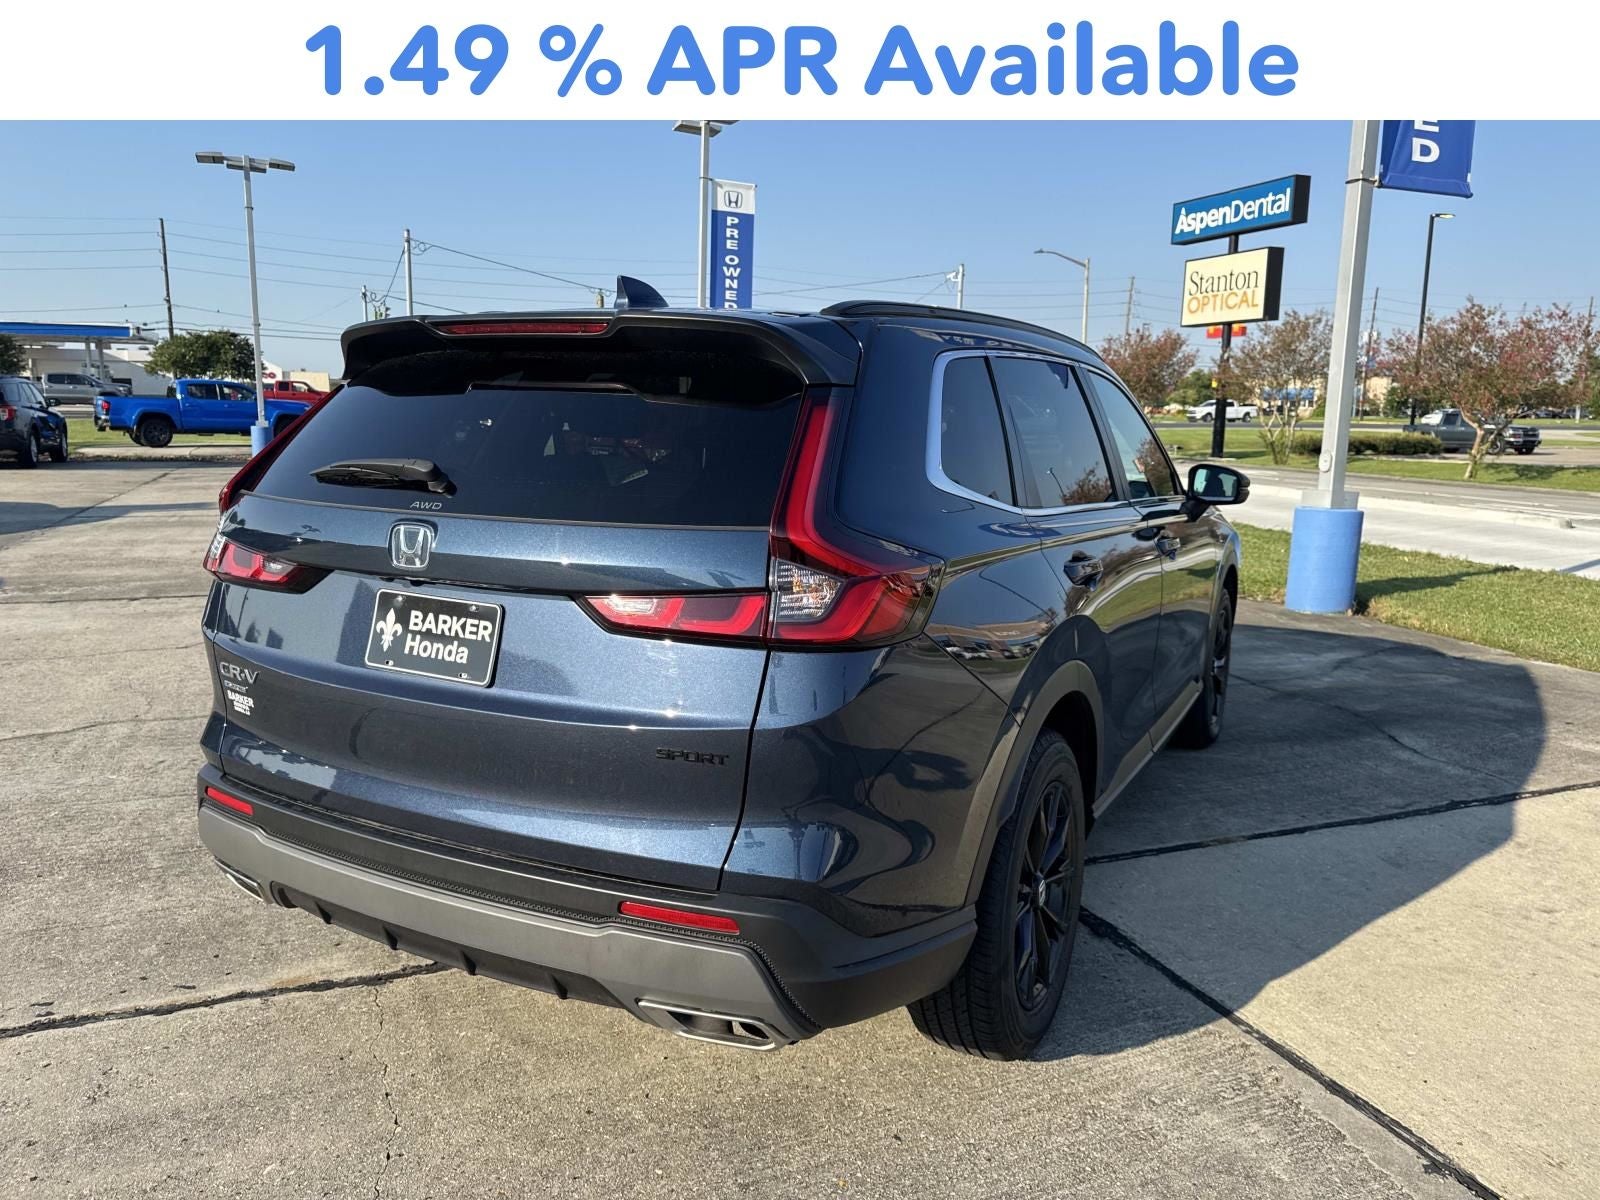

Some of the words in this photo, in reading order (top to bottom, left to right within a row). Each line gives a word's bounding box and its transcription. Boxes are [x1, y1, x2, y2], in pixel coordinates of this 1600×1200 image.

[725, 215, 739, 250] PRE
[1188, 269, 1259, 297] Stanton
[1187, 290, 1259, 315] OPTICAL
[410, 501, 442, 510] AWD
[408, 609, 493, 642] BARKER
[403, 633, 469, 664] Honda
[219, 661, 260, 684] CR-V
[656, 747, 729, 766] SPORT
